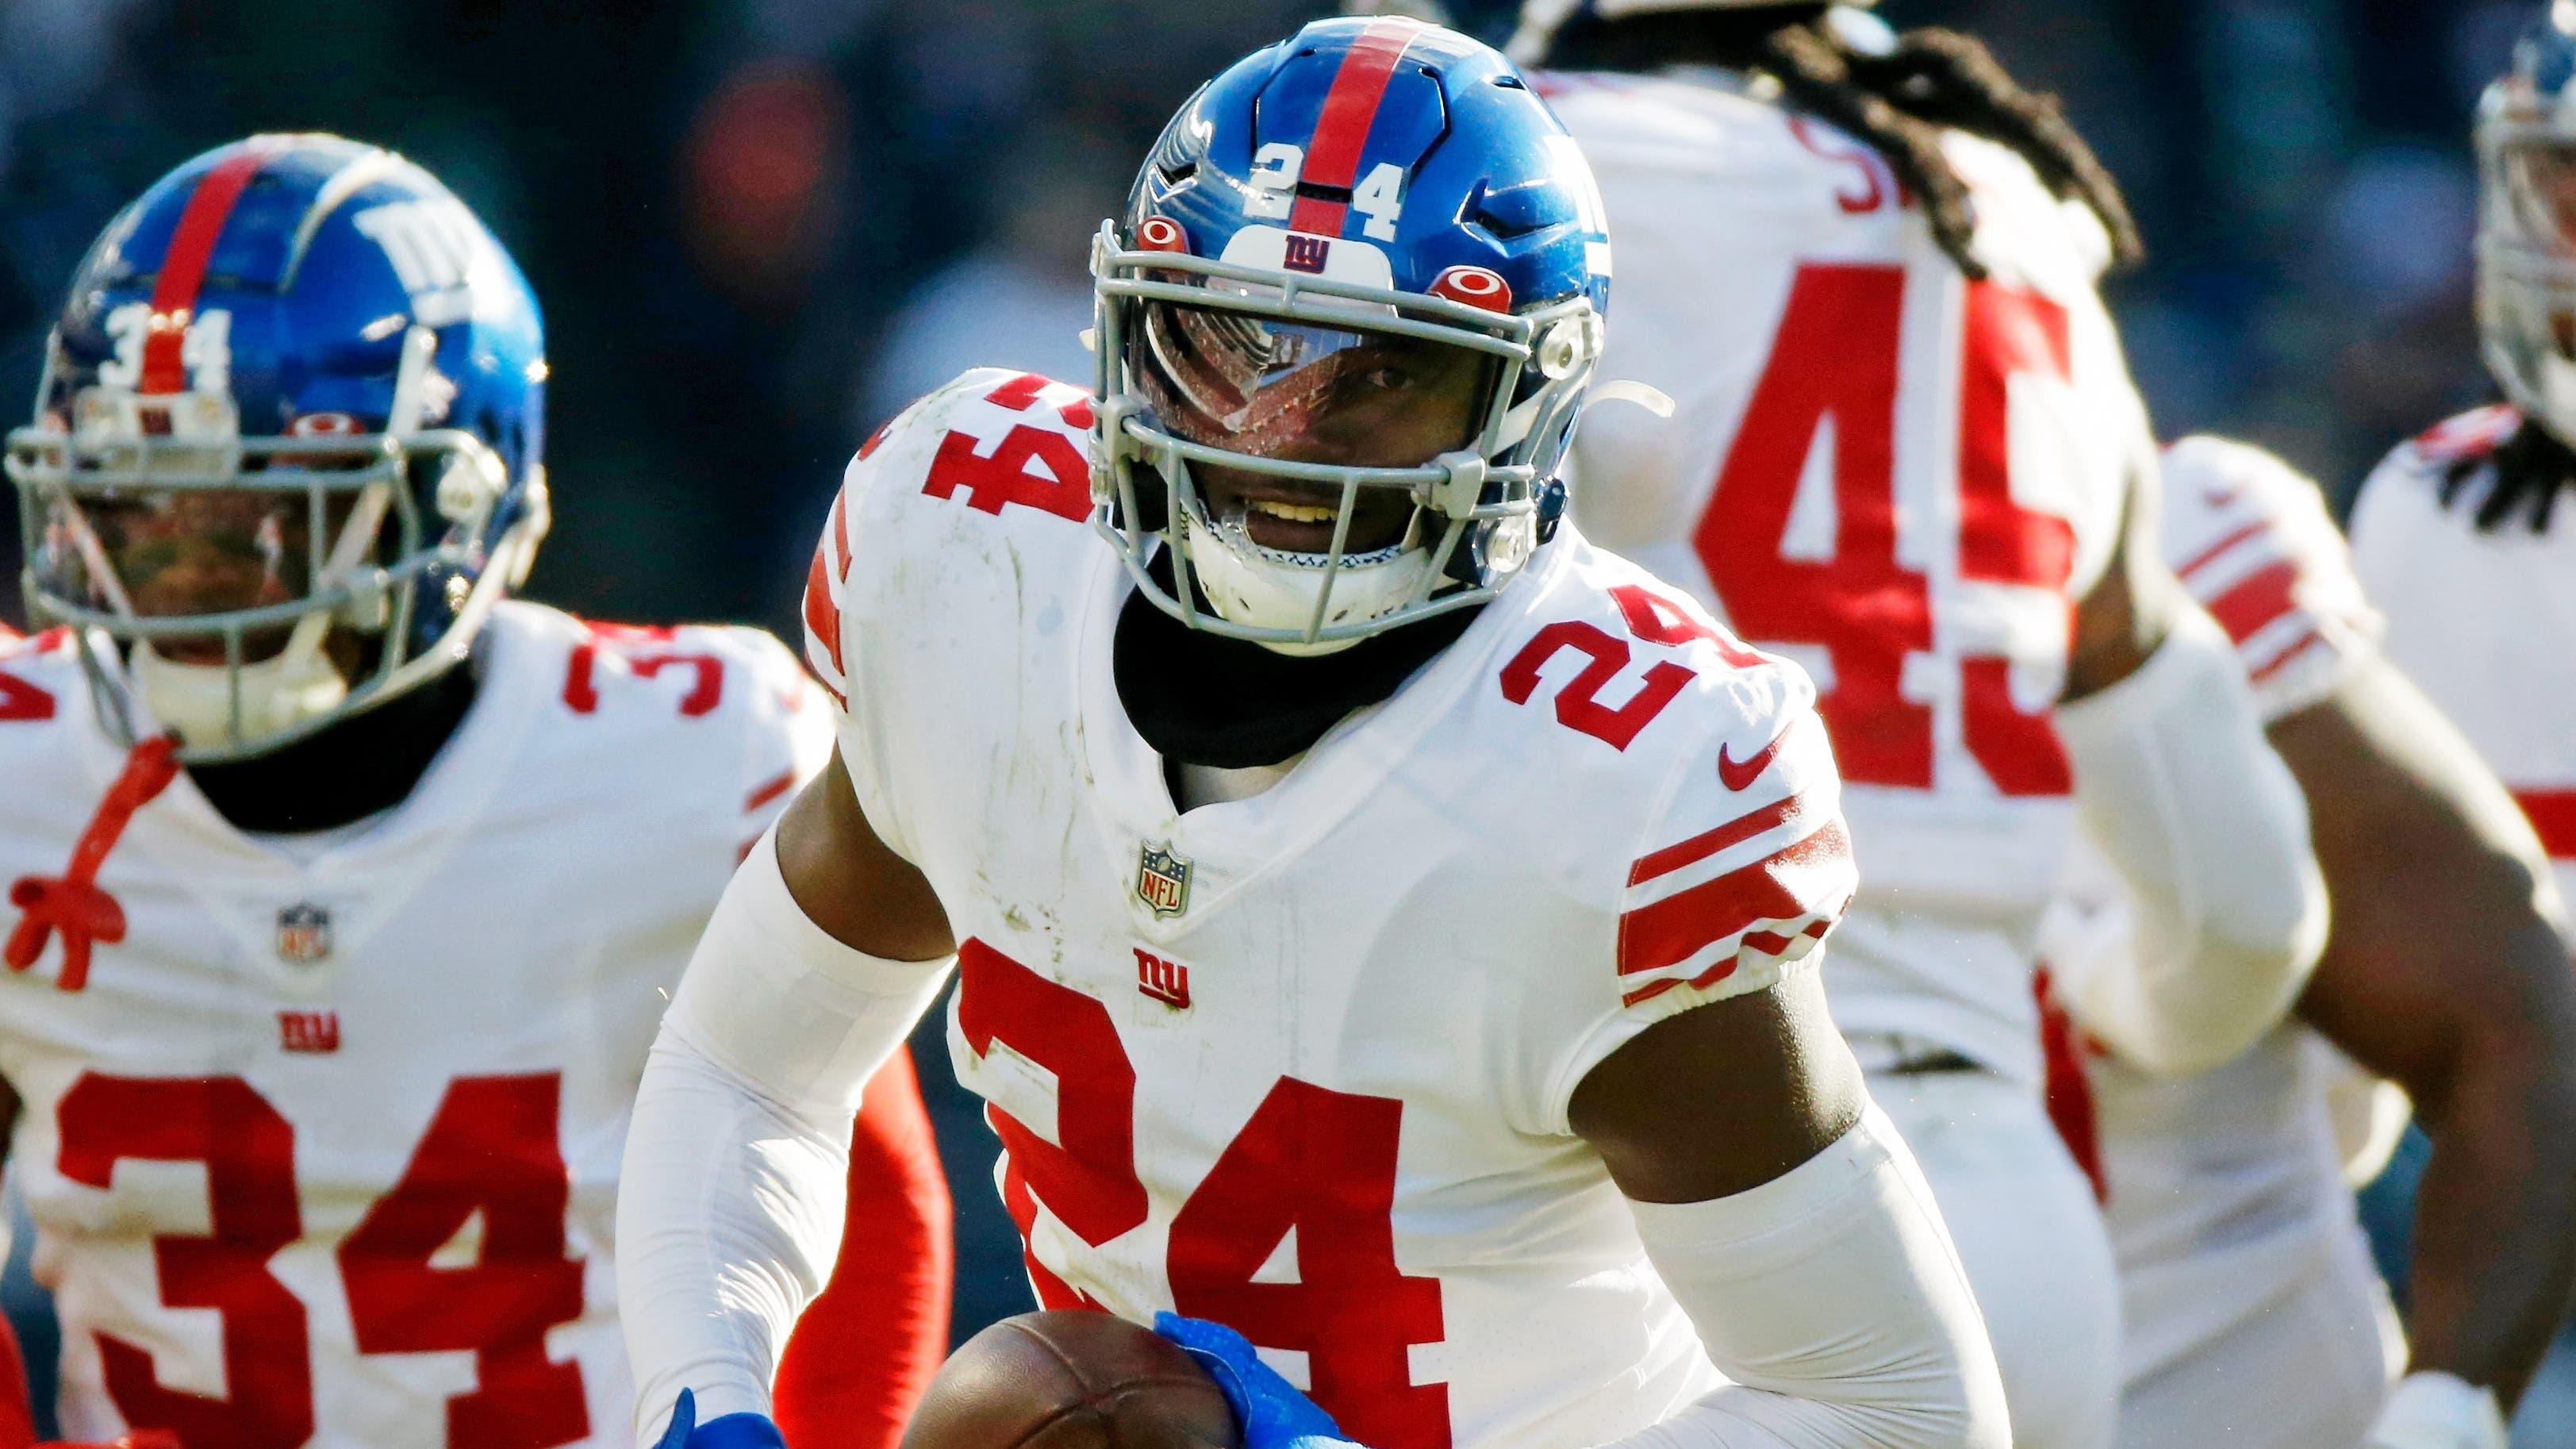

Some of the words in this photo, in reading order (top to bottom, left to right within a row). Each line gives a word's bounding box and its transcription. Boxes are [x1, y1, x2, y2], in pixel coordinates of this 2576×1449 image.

[1242, 141, 1404, 243] 24
[98, 302, 232, 394] 34
[1691, 262, 2077, 798] 45
[1499, 584, 1777, 752] 24
[1142, 871, 1178, 907] NFL
[1133, 947, 1191, 1009] ny
[56, 1069, 592, 1449] 34
[958, 936, 1453, 1449] 24
